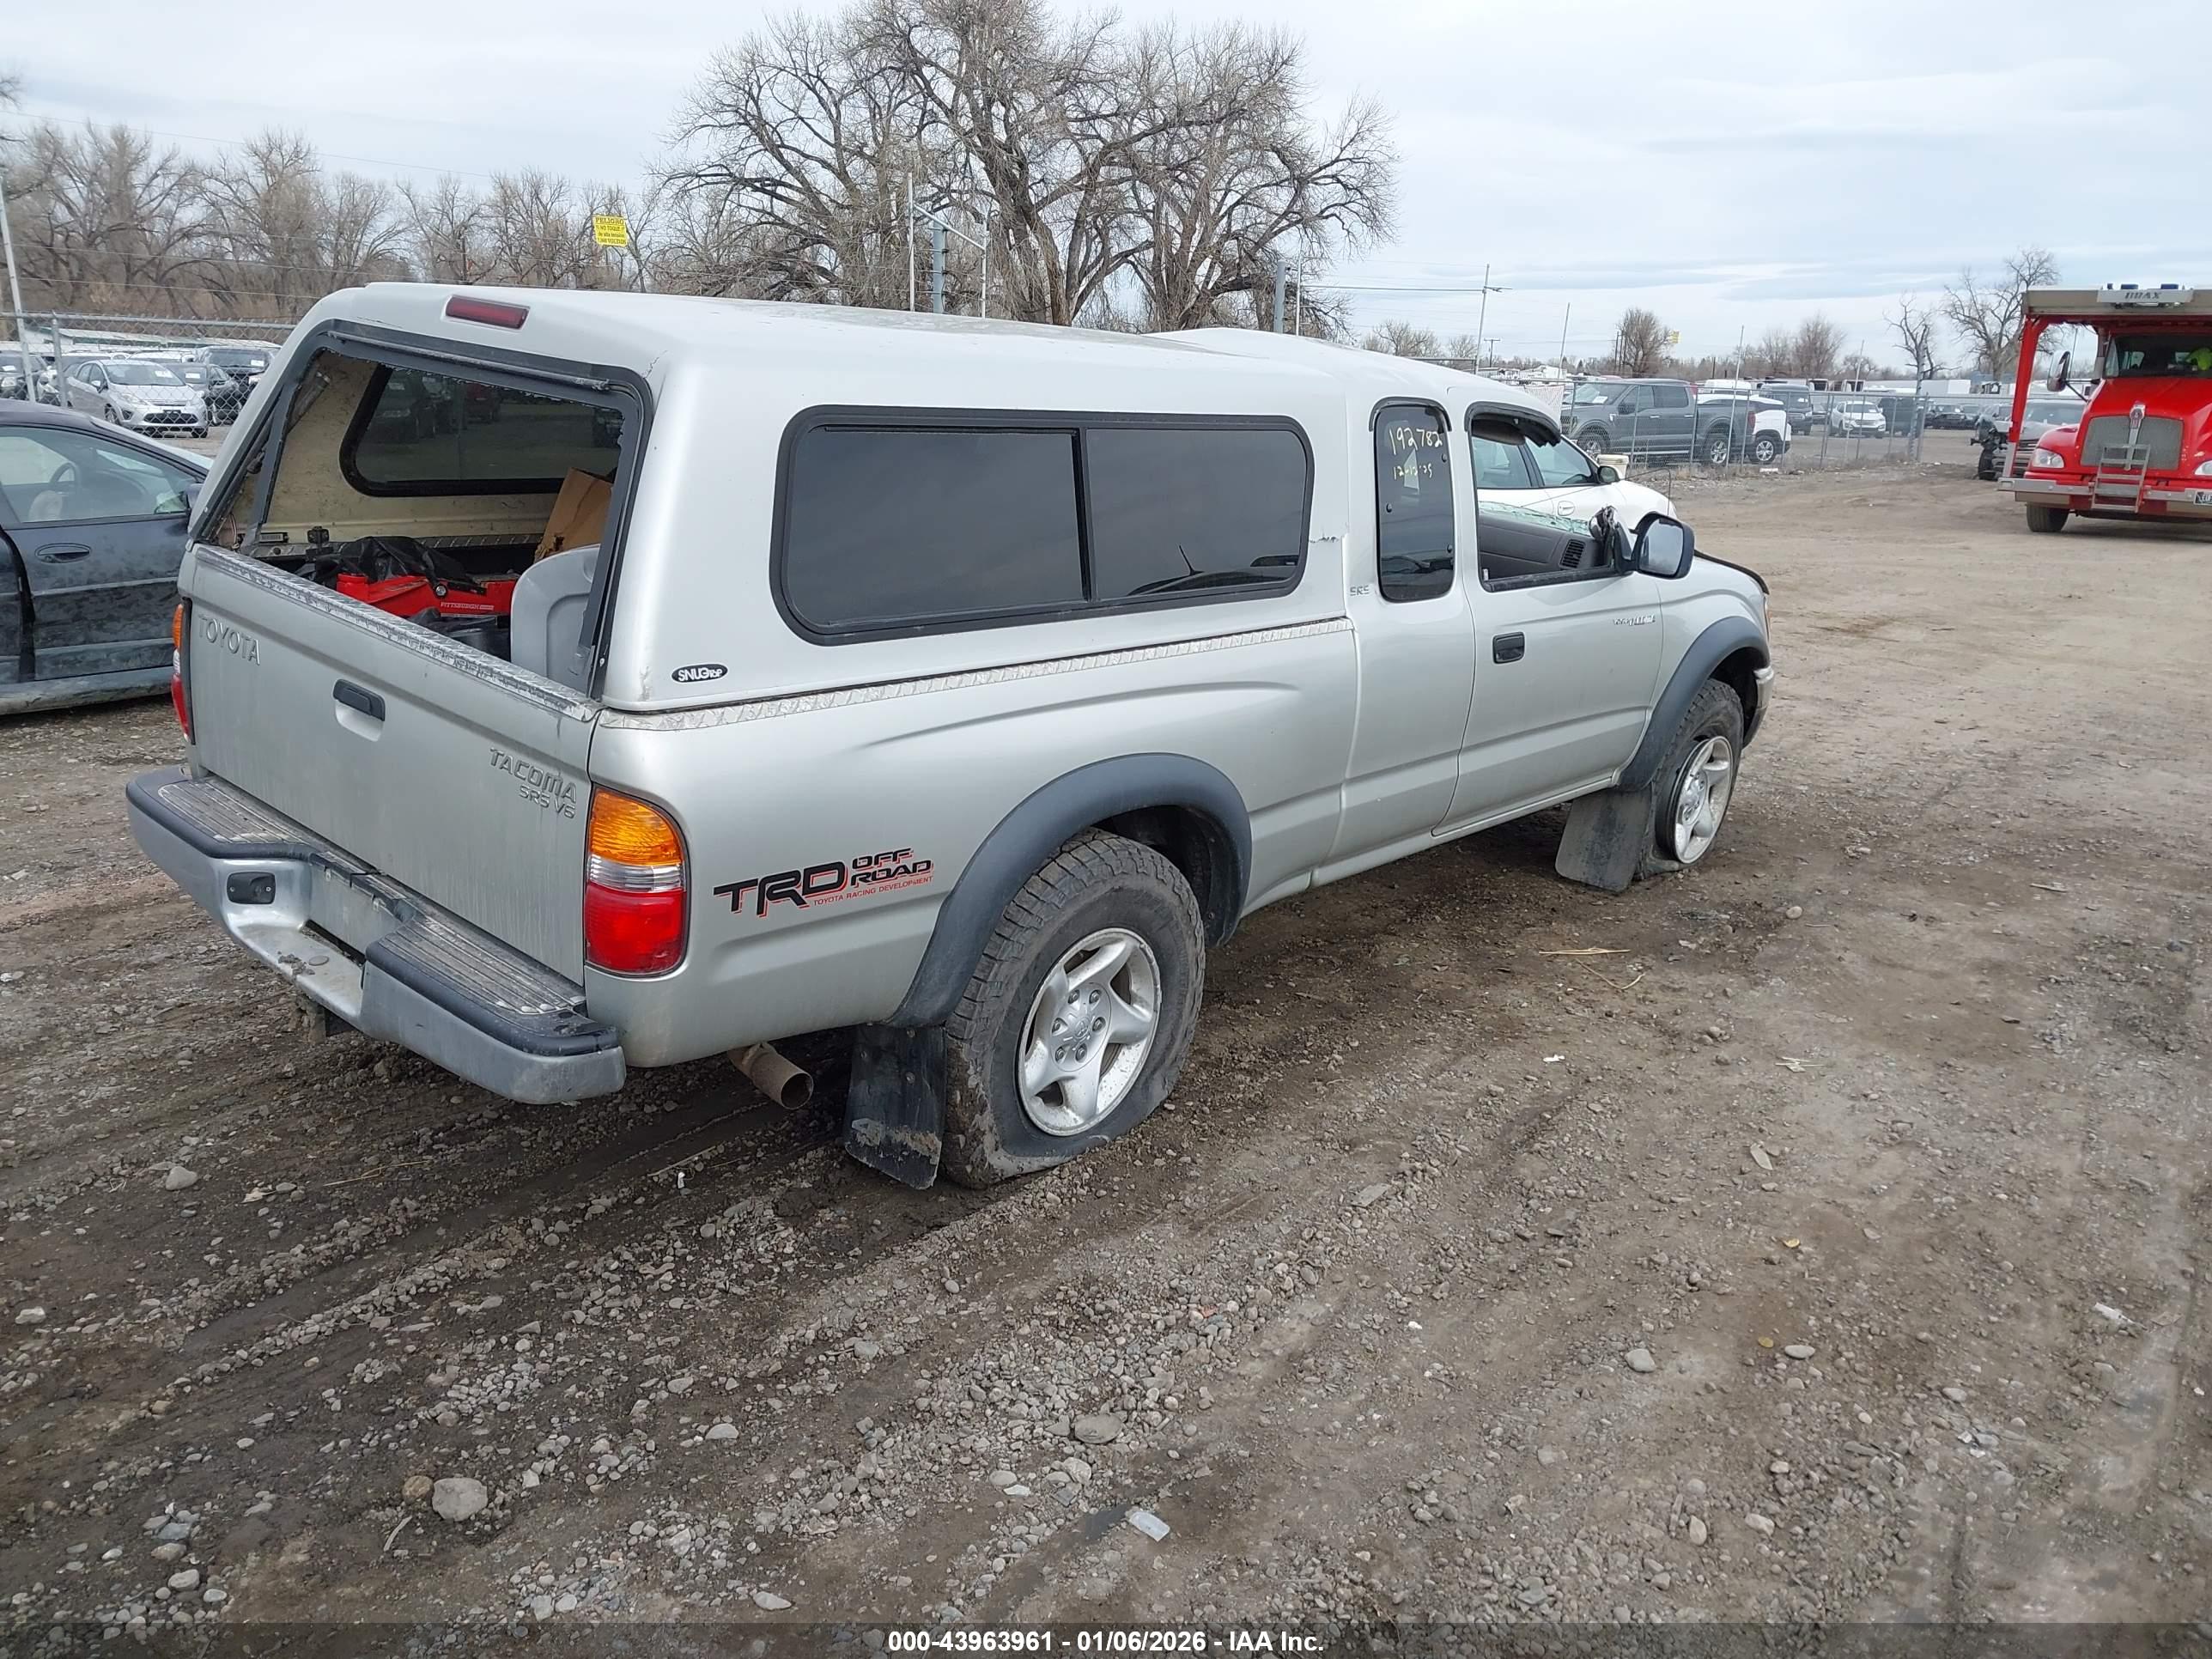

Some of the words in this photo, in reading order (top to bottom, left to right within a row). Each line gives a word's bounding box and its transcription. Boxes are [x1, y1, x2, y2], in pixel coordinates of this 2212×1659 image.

[1389, 427, 1443, 456] 192782
[198, 614, 260, 666] TOYOTA
[489, 746, 577, 804] TACOMA
[519, 783, 550, 808] SR5
[554, 797, 575, 819] V6
[850, 860, 934, 888] ROAD
[852, 848, 914, 870] OFF
[713, 860, 849, 918] TRD
[813, 894, 844, 907] TOYOTA
[846, 887, 877, 900] RACING
[878, 875, 934, 892] DEVELOPMENT
